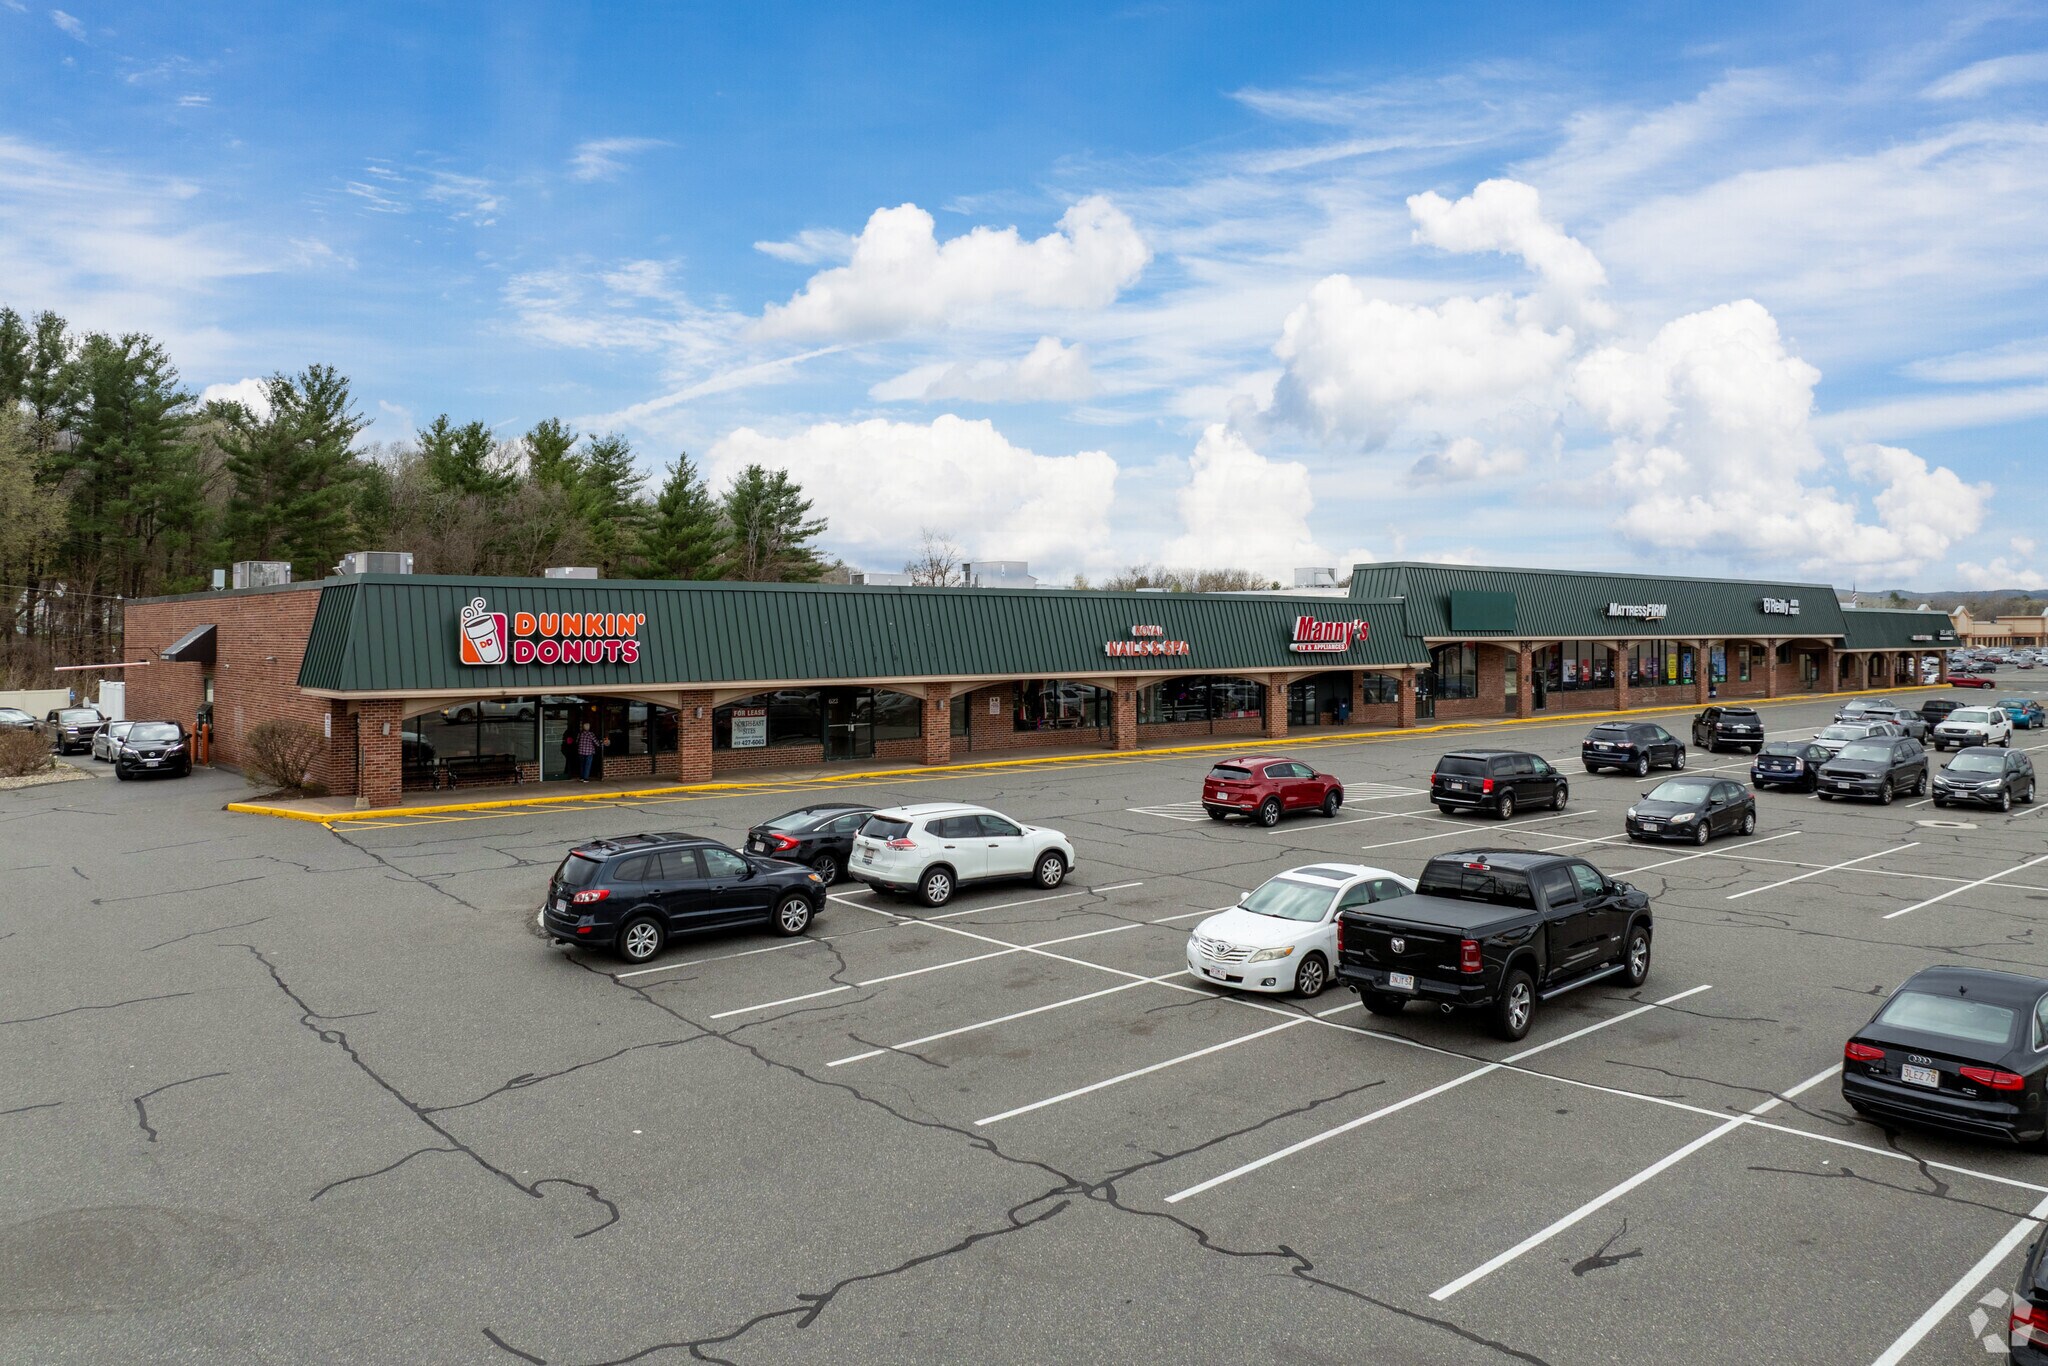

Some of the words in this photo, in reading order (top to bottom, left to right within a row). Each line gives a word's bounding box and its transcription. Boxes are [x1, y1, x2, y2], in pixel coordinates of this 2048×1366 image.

[514, 612, 646, 637] DUNKIN'
[1132, 624, 1163, 636] ROYAL
[1294, 616, 1369, 650] Manny's
[514, 639, 637, 664] DONUTS
[1107, 640, 1149, 656] NAILS
[1151, 640, 1161, 656] &
[1163, 639, 1189, 655] SPA
